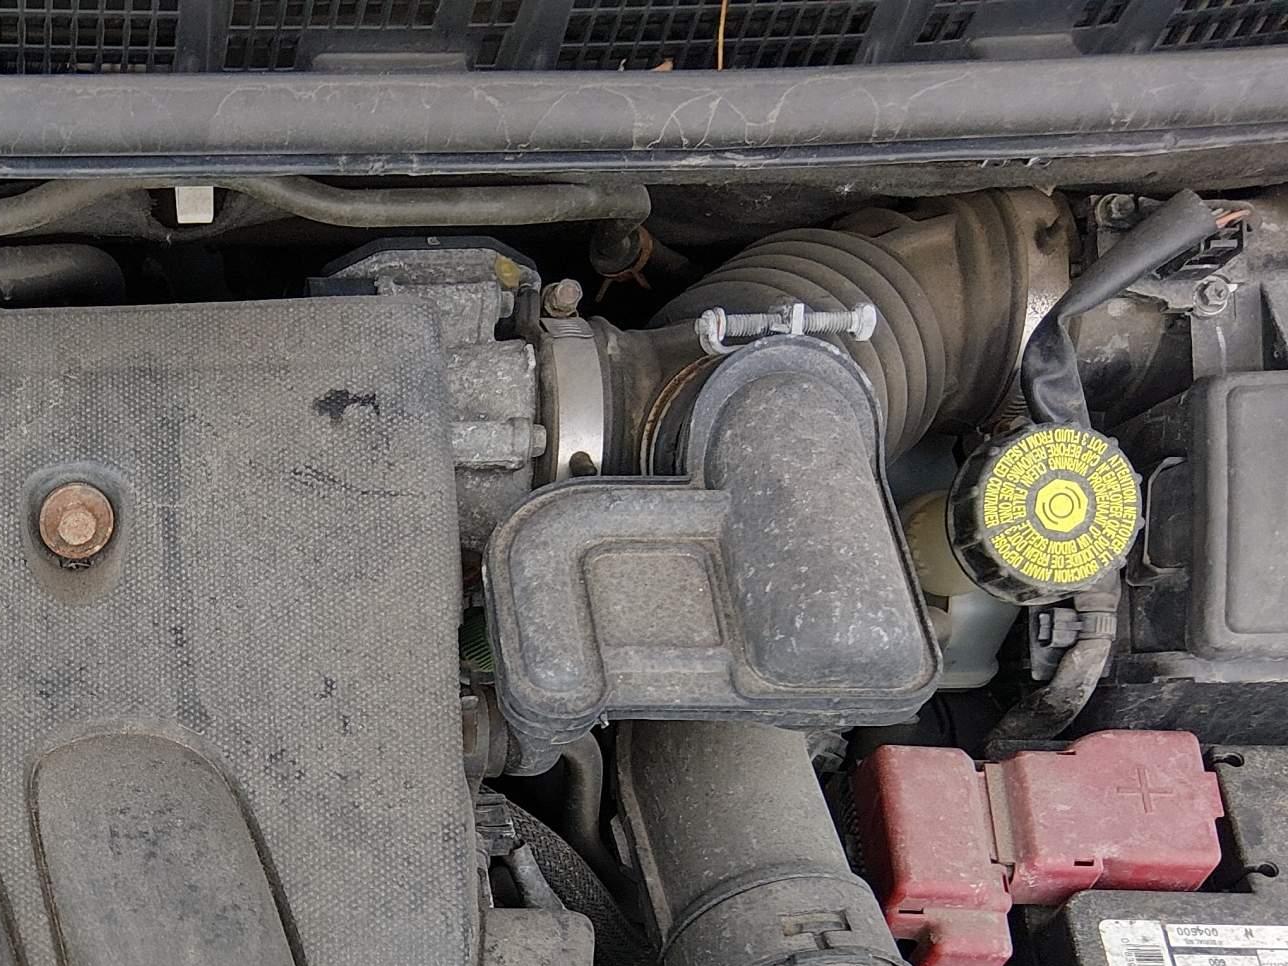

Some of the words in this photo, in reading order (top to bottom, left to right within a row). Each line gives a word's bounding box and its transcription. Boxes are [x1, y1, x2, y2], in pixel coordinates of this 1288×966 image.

[1020, 440, 1029, 450] A
[1028, 430, 1053, 447] FROM
[1055, 429, 1081, 442] FLUID
[1082, 433, 1089, 445] 3
[1087, 436, 1108, 454] DOT
[1047, 443, 1082, 457] BEFORE
[1082, 448, 1100, 466] CAP
[993, 445, 1023, 476] SEALED
[1007, 447, 1047, 483] REMOVING
[1049, 456, 1089, 475] WARNING
[1021, 462, 1047, 487] CLEAN
[1107, 454, 1137, 502] ATTENTION
[1003, 482, 1016, 498] USE
[984, 477, 1003, 528] CONTAINER
[1014, 489, 1028, 518] FILLER
[1087, 472, 1109, 528] PROVENANT
[999, 498, 1013, 524] ONLY
[1005, 526, 1016, 534] 3
[1018, 520, 1049, 550] SCELLE
[1103, 518, 1120, 537] QUE
[1113, 506, 1137, 555] NETTOYER
[1010, 533, 1027, 551] DOT
[1048, 540, 1078, 554] BIDON
[1093, 533, 1110, 551] DU
[1023, 547, 1050, 566] FREIN
[1051, 555, 1064, 568] DE
[1064, 547, 1096, 568] LIQUIDE
[1099, 554, 1113, 567] LE
[1020, 562, 1053, 582] AVANT
[1053, 561, 1100, 583] BOUCHON
